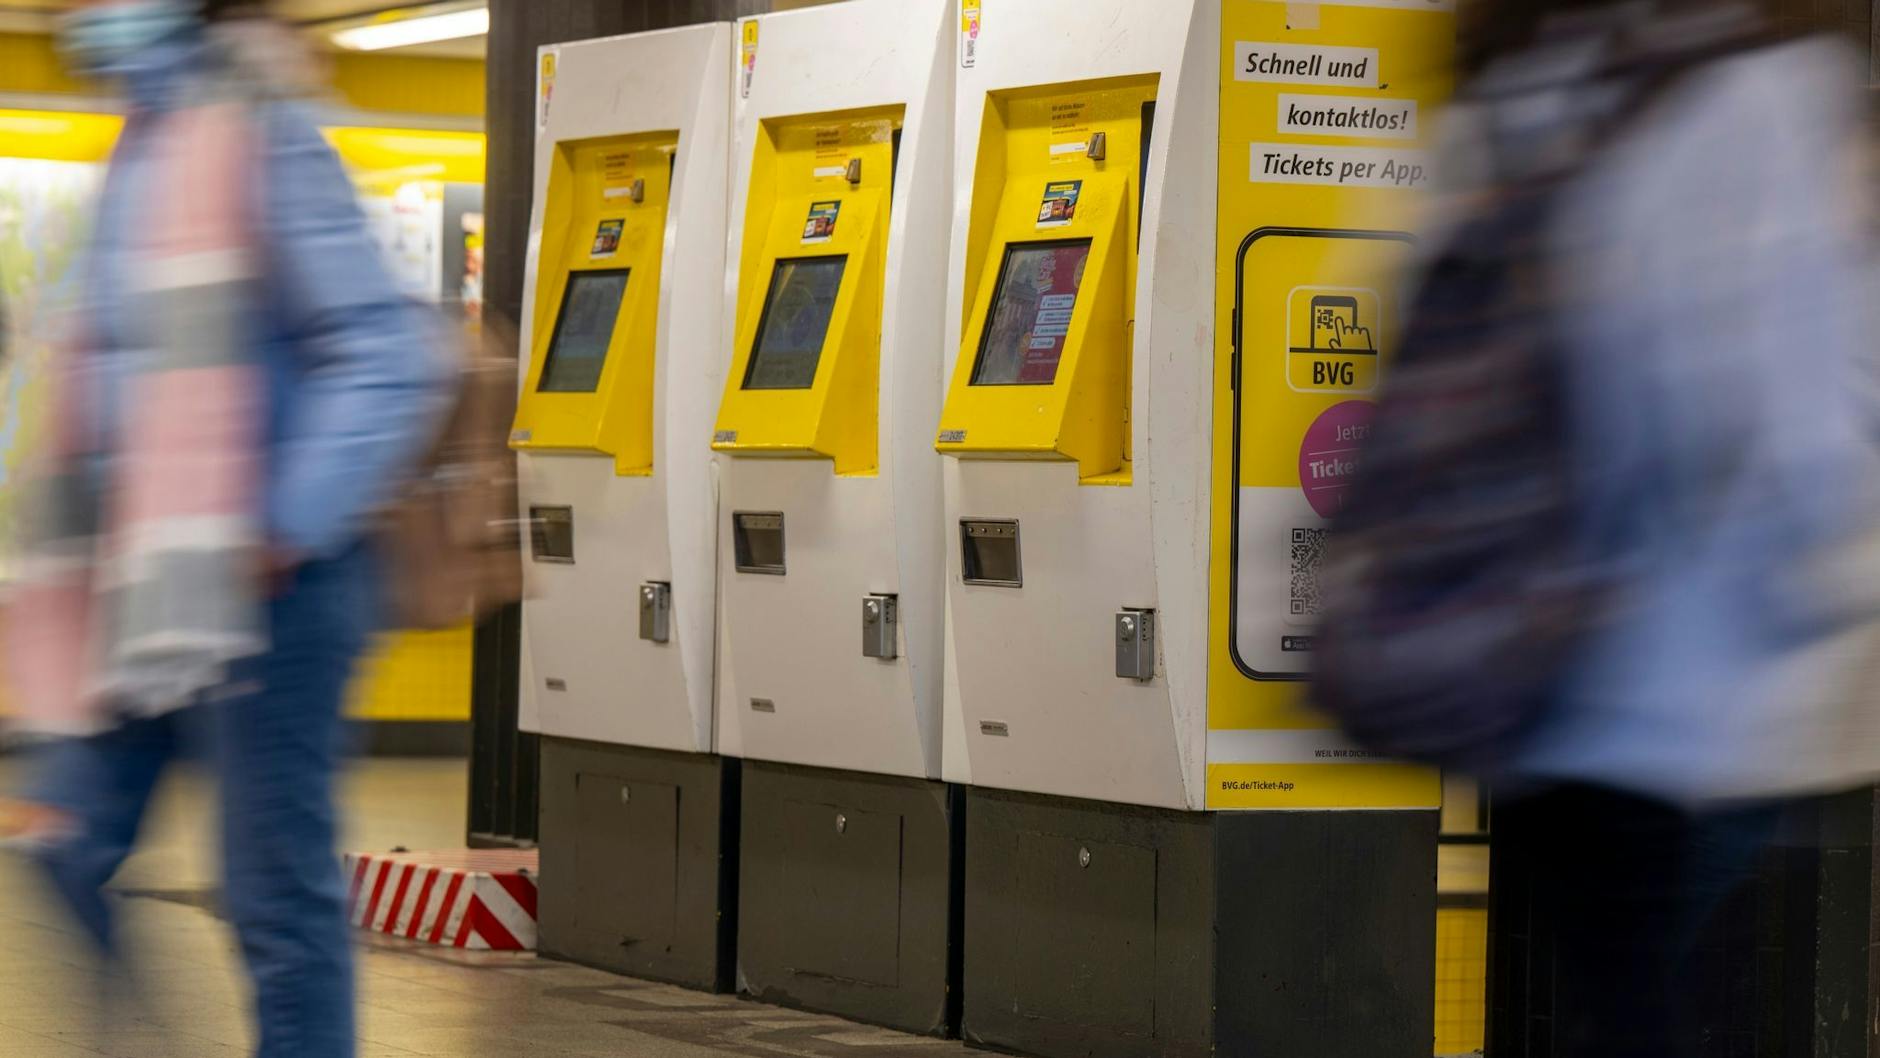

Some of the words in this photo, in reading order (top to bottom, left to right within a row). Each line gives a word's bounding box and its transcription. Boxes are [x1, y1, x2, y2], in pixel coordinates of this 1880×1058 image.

[1245, 52, 1323, 76] Schnell
[1327, 57, 1368, 79] und
[1287, 103, 1408, 130] kontaktlos!
[1263, 153, 1334, 177] Tickets
[1339, 160, 1376, 183] per
[1380, 159, 1428, 186] App.
[1312, 361, 1354, 385] BVG
[1314, 749, 1331, 758] WEIL
[1333, 749, 1347, 758] WIR
[1221, 780, 1295, 791] BVG.de/Ticket-App
